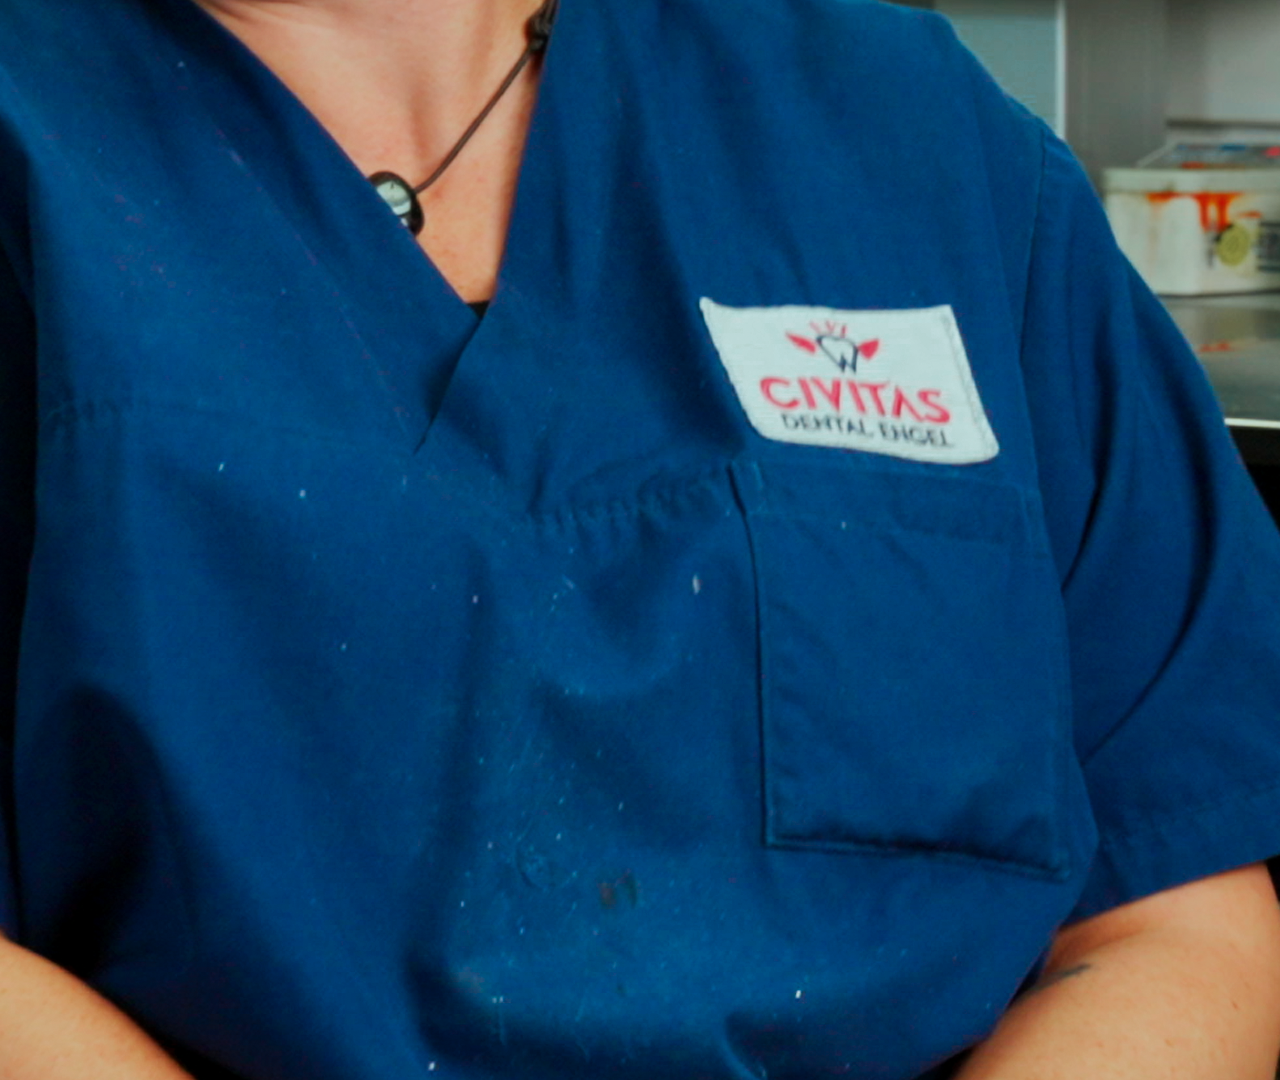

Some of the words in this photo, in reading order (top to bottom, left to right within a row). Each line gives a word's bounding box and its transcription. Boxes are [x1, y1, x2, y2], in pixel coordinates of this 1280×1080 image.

[759, 376, 951, 424] CIVITAS
[781, 413, 873, 438] DENTAL
[878, 422, 955, 447] ENGEL
